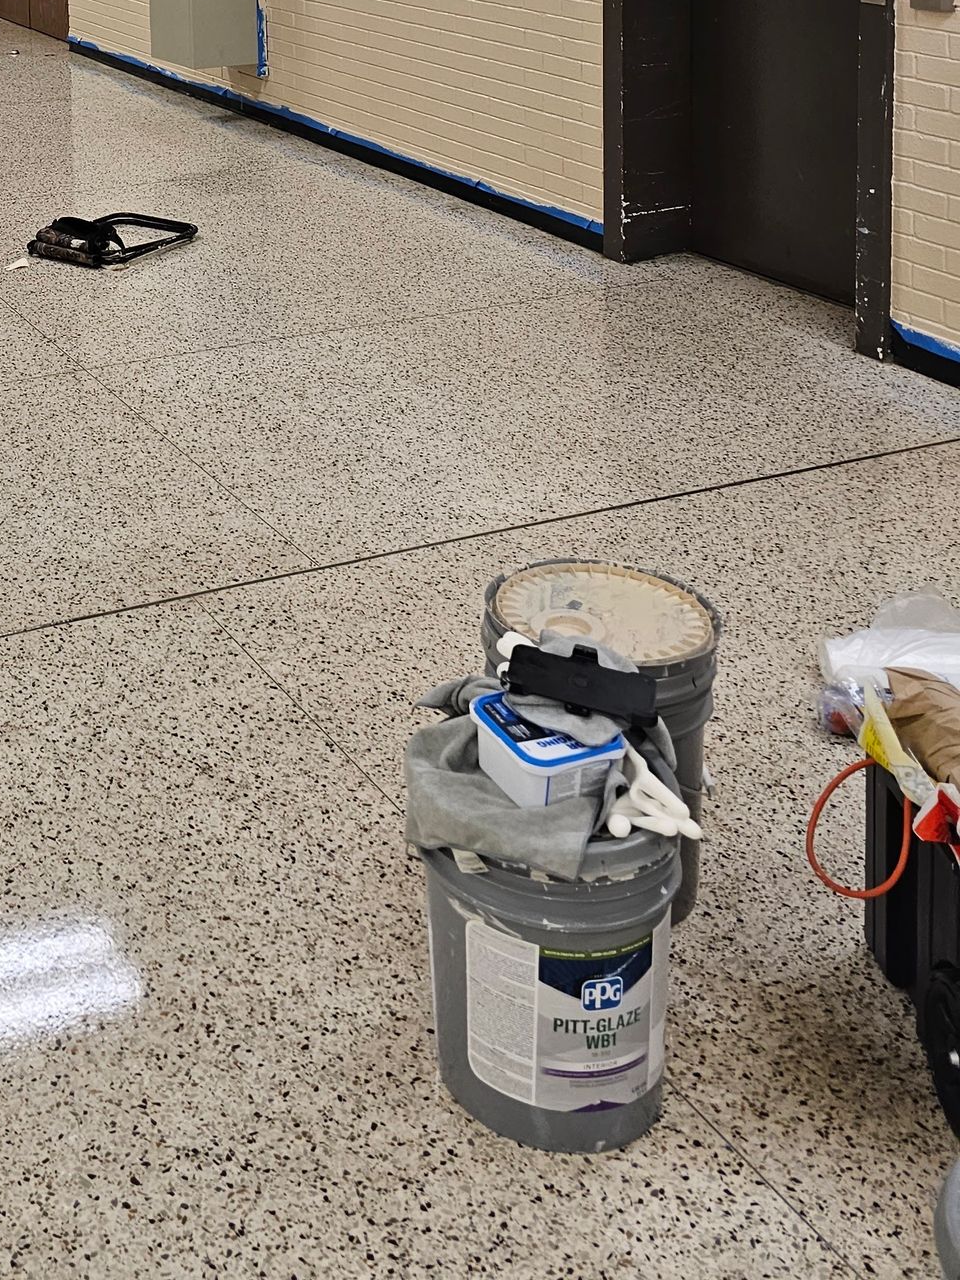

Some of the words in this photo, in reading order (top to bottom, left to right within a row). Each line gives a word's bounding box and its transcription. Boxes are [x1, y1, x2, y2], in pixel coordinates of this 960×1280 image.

[584, 982, 621, 1009] PPG
[553, 1006, 641, 1034] PITT-GLAZE
[586, 1032, 617, 1050] WB1
